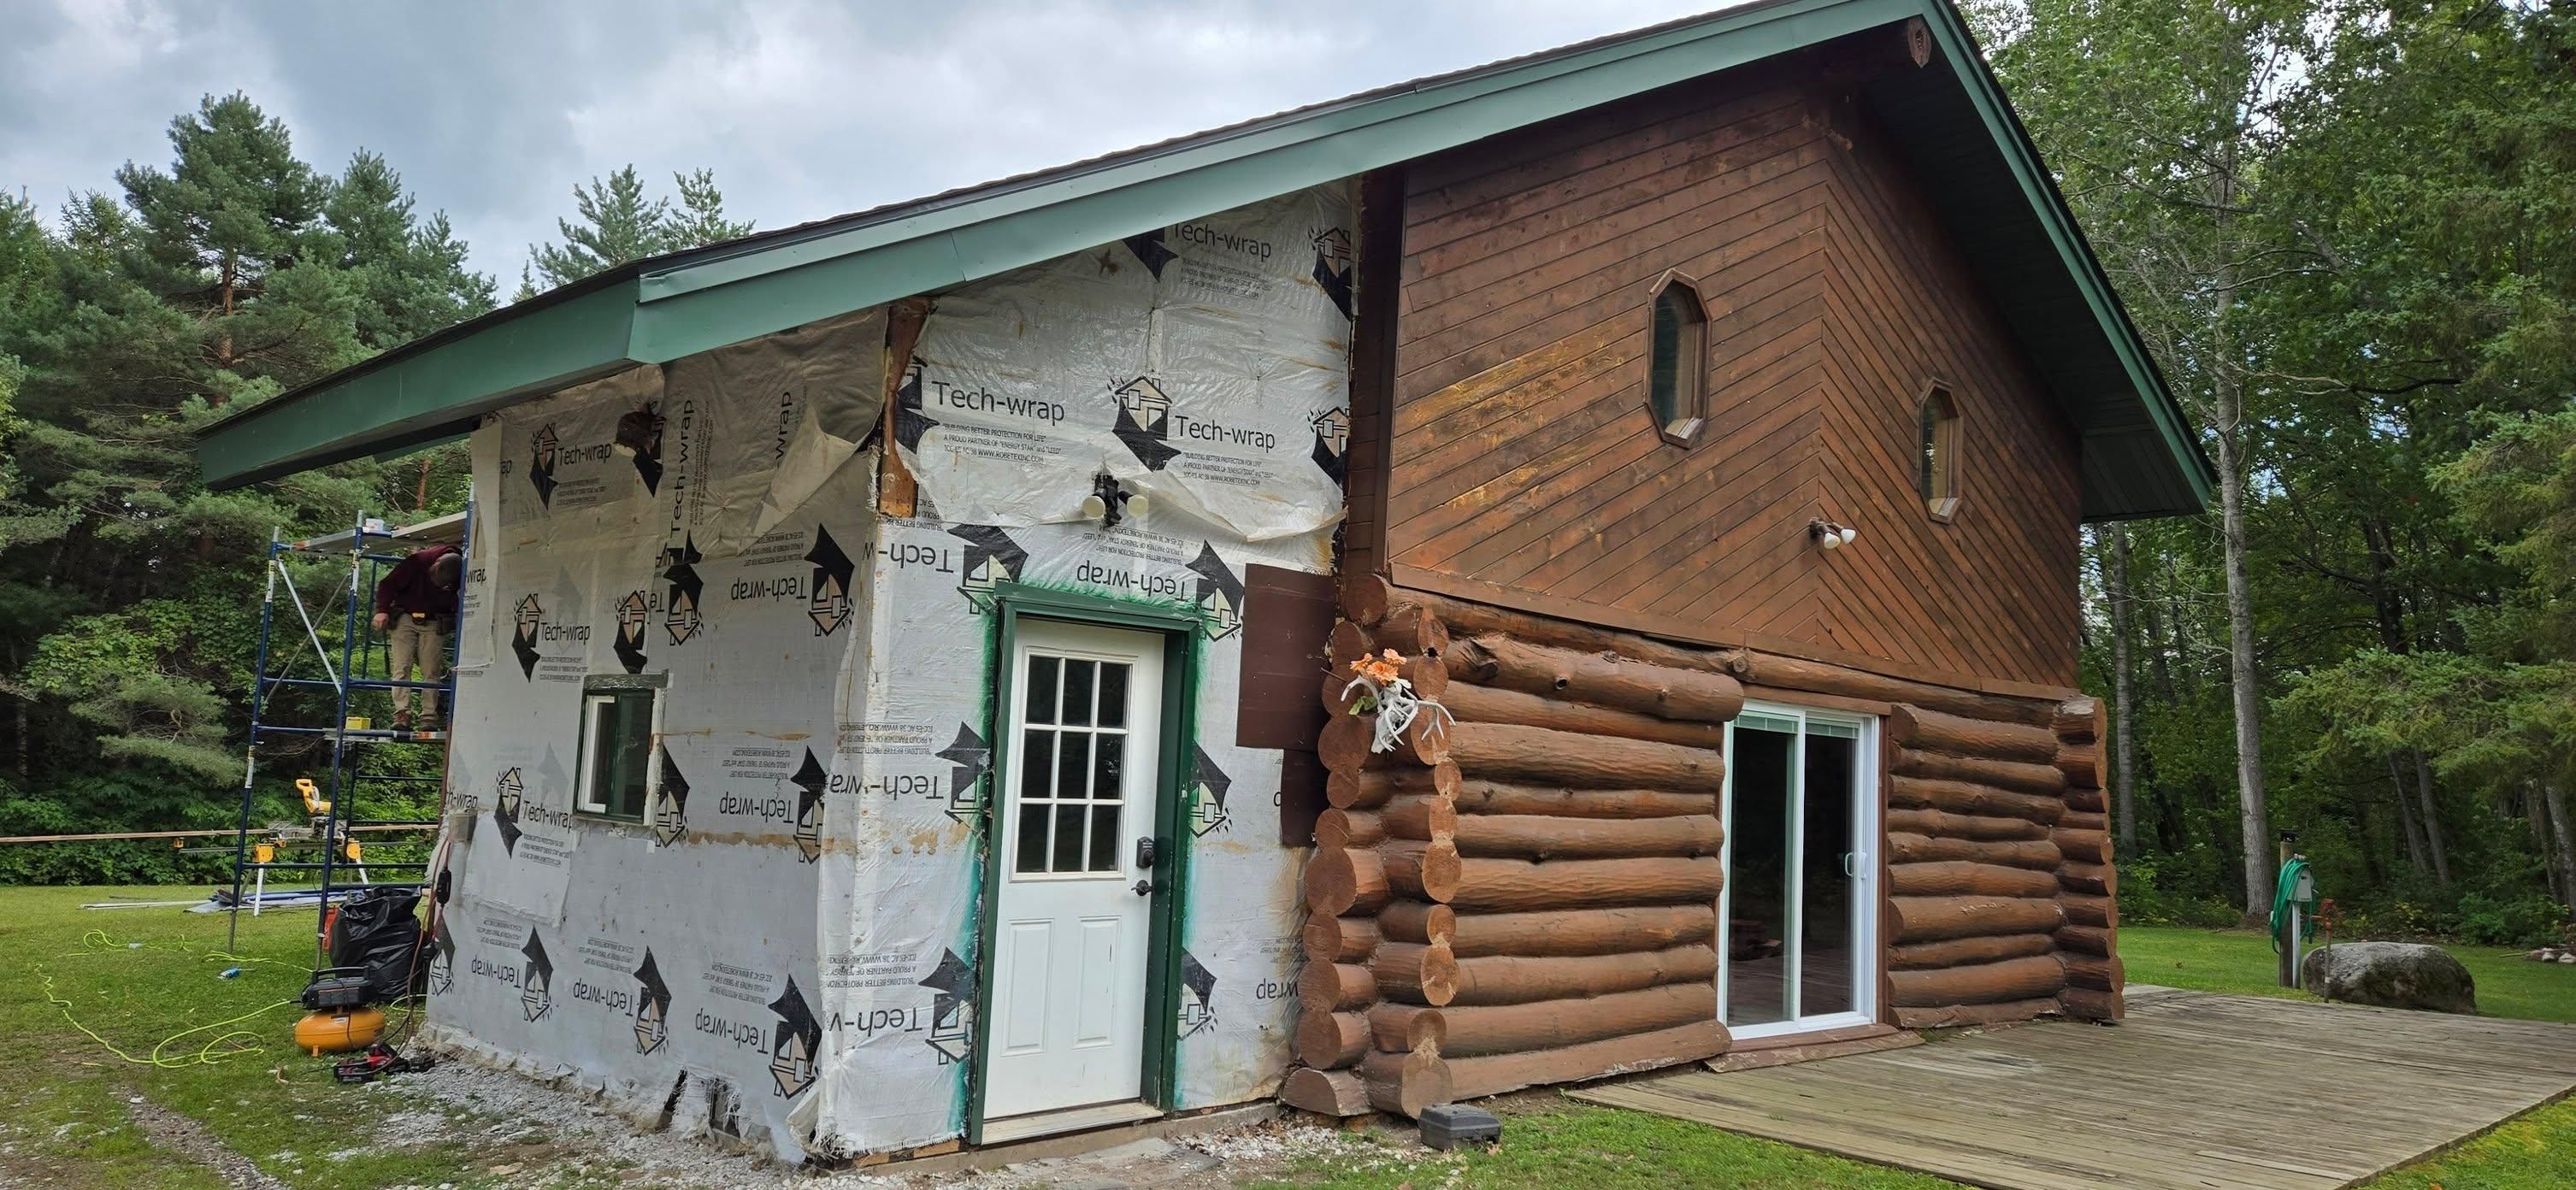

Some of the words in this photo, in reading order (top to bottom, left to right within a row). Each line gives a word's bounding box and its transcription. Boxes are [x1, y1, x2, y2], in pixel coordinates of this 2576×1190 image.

[931, 381, 1064, 426] Tech-wrap
[1175, 415, 1275, 453] Tech-wrap
[557, 443, 612, 466] Tech-wrap
[670, 400, 694, 539] Tech-wrap
[862, 542, 954, 573] Tech-w
[731, 576, 807, 602] Tech-wrap
[1076, 560, 1188, 602] Tech-wrap
[540, 622, 590, 645] Tech-wrap
[829, 774, 944, 800] Tech-wra
[719, 792, 793, 823] Tech-wrap
[471, 954, 522, 988] Tech-wrap
[574, 978, 633, 1016] Tech-wrap
[696, 1008, 768, 1054] Tech-wrap
